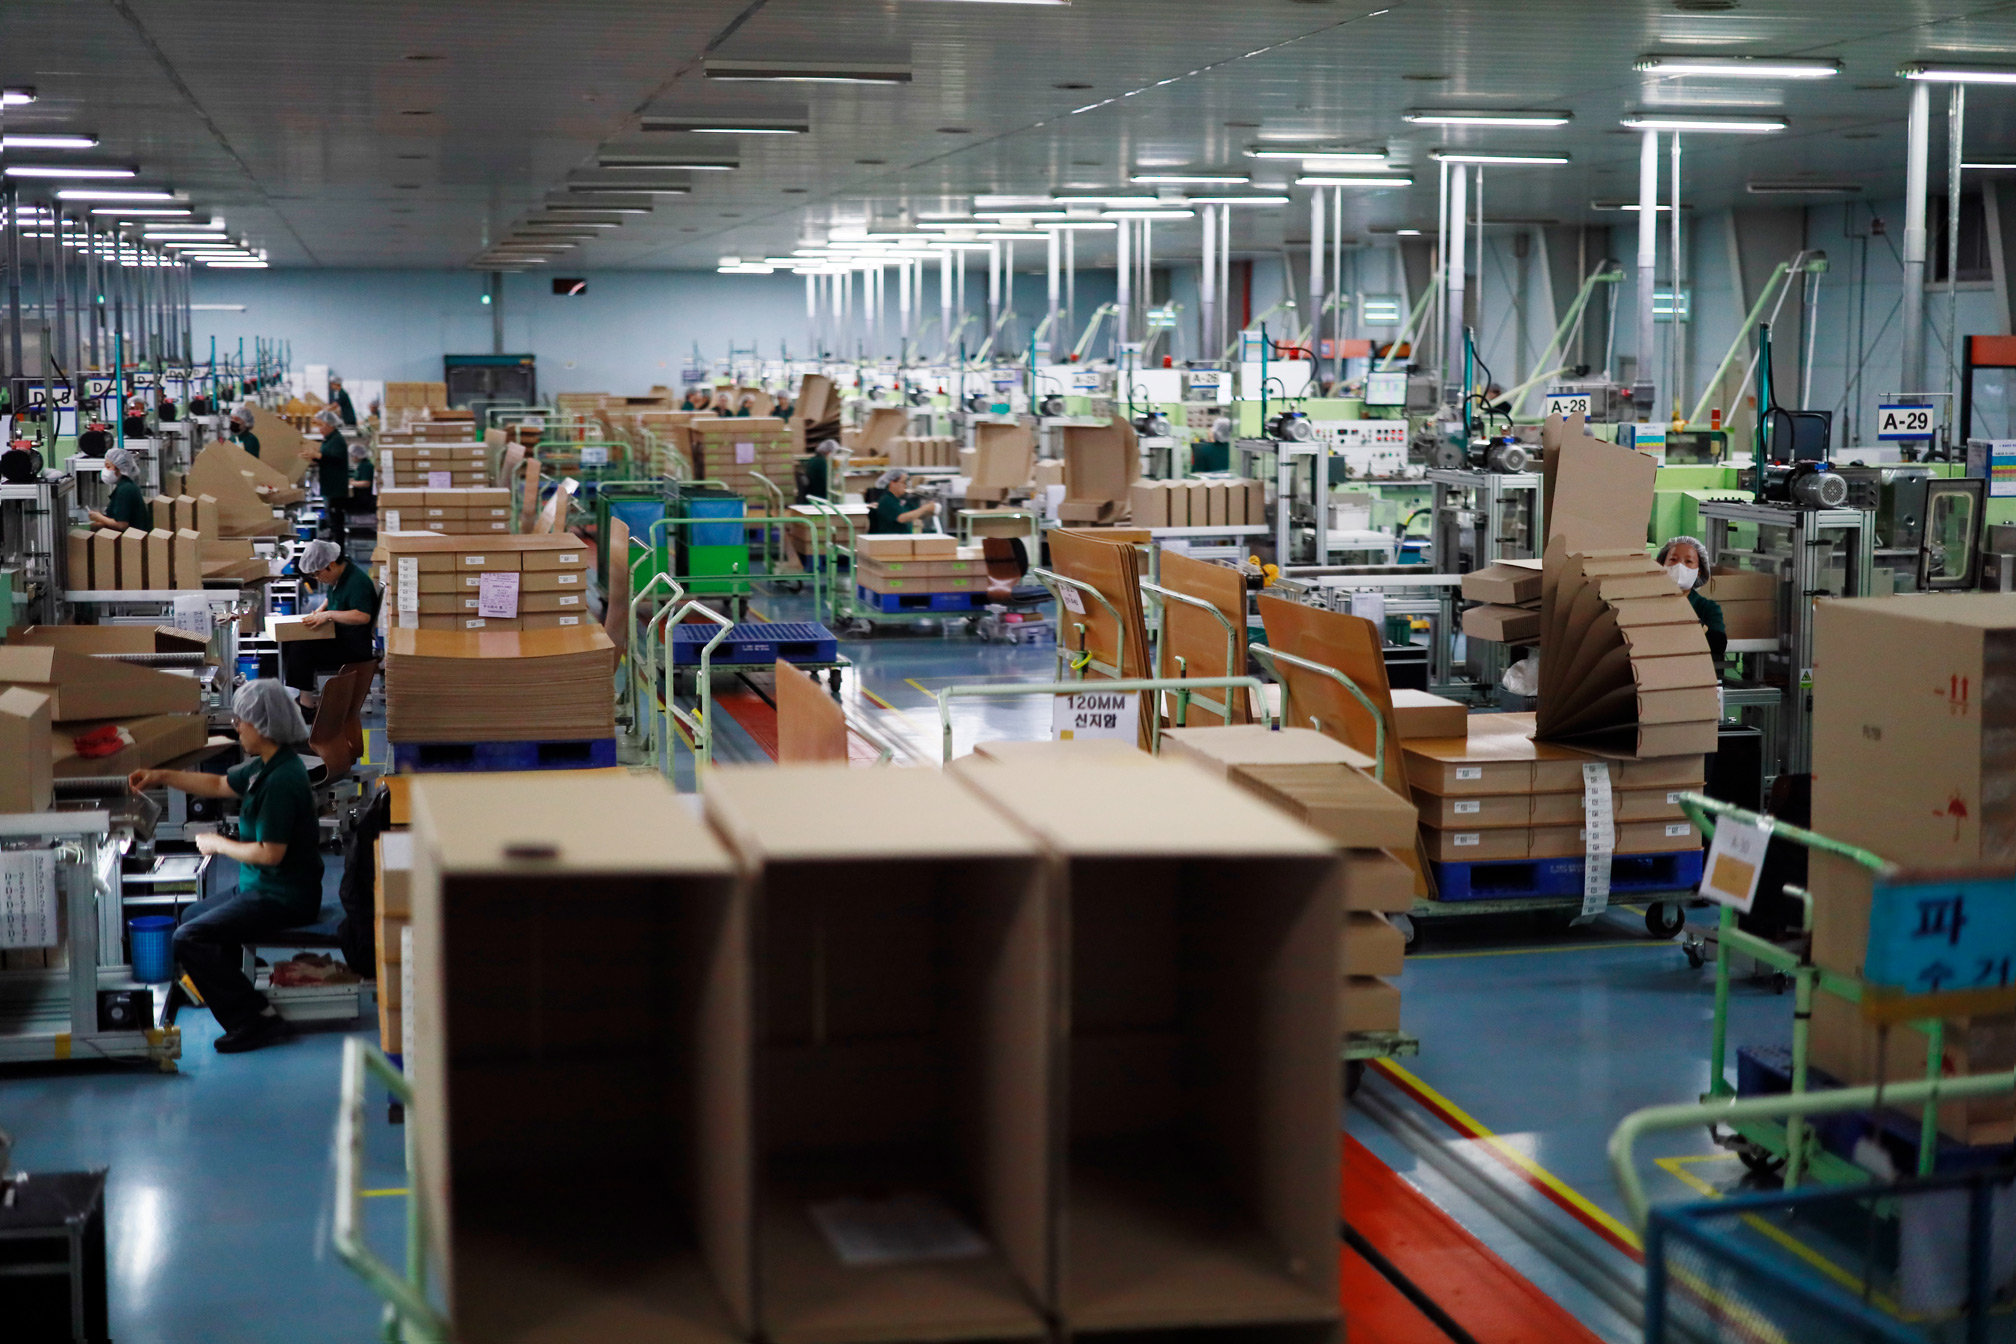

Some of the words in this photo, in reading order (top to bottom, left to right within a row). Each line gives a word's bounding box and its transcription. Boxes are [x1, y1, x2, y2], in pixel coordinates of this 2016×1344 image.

[1550, 398, 1588, 413] A-28
[1882, 411, 1929, 431] A-29
[1067, 695, 1126, 710] 120MM
[1912, 894, 1968, 946] 파
